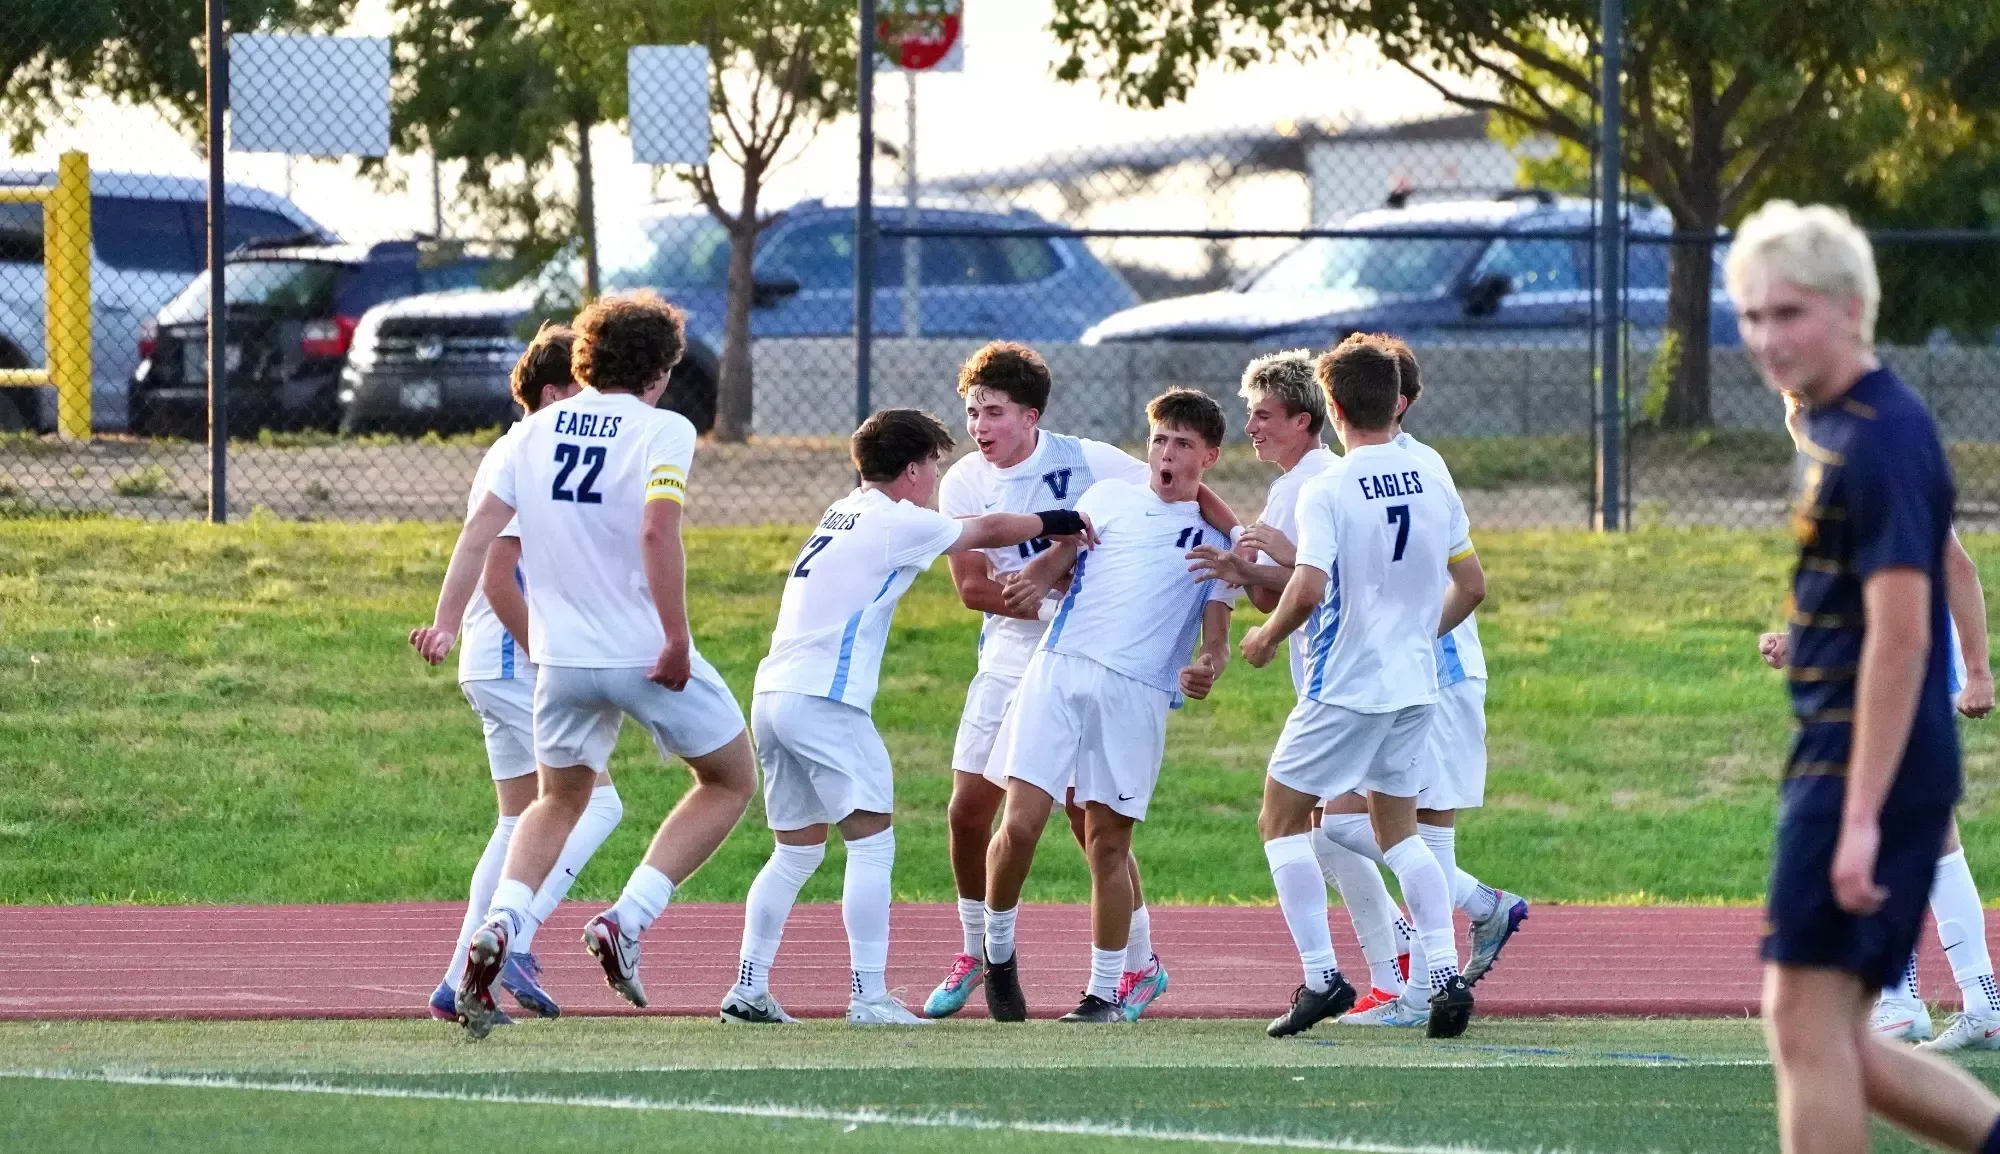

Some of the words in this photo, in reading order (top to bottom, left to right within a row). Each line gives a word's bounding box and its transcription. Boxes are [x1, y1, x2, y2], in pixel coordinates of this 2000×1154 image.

[555, 410, 622, 437] EAGLES
[552, 443, 607, 504] 22
[1042, 468, 1072, 500] V
[1358, 471, 1423, 500] EAGLES
[820, 509, 861, 531] AGLES
[1386, 504, 1410, 562] 7
